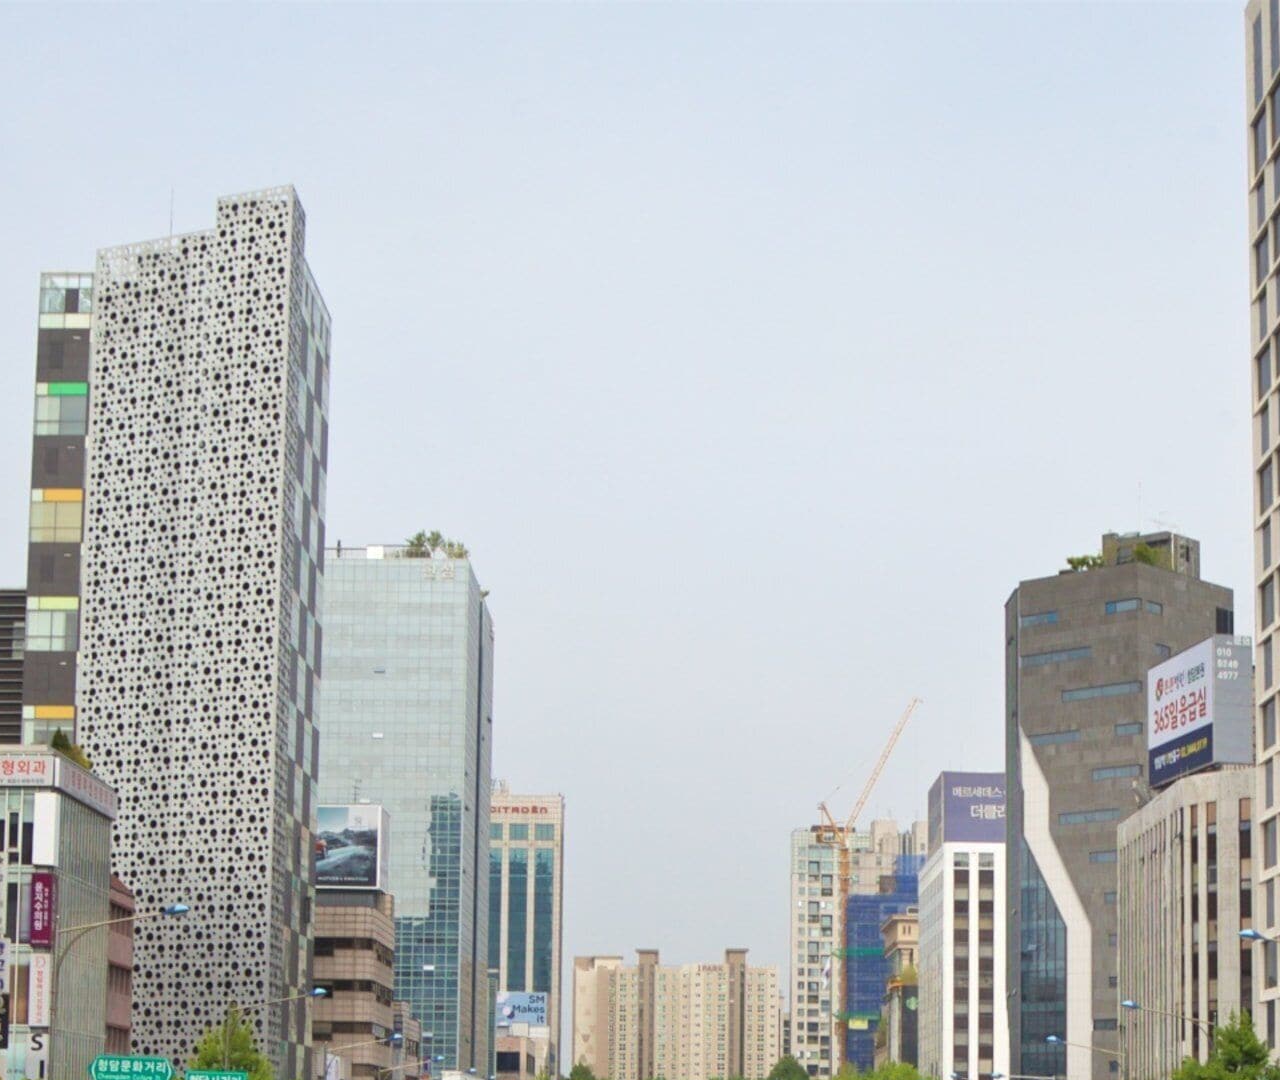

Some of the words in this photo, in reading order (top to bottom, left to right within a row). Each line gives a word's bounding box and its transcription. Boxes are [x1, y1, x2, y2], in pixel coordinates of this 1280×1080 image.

[528, 994, 545, 1004] SM
[512, 1004, 545, 1014] Makes
[536, 1014, 545, 1025] it
[97, 1059, 166, 1074] 청담문화거리
